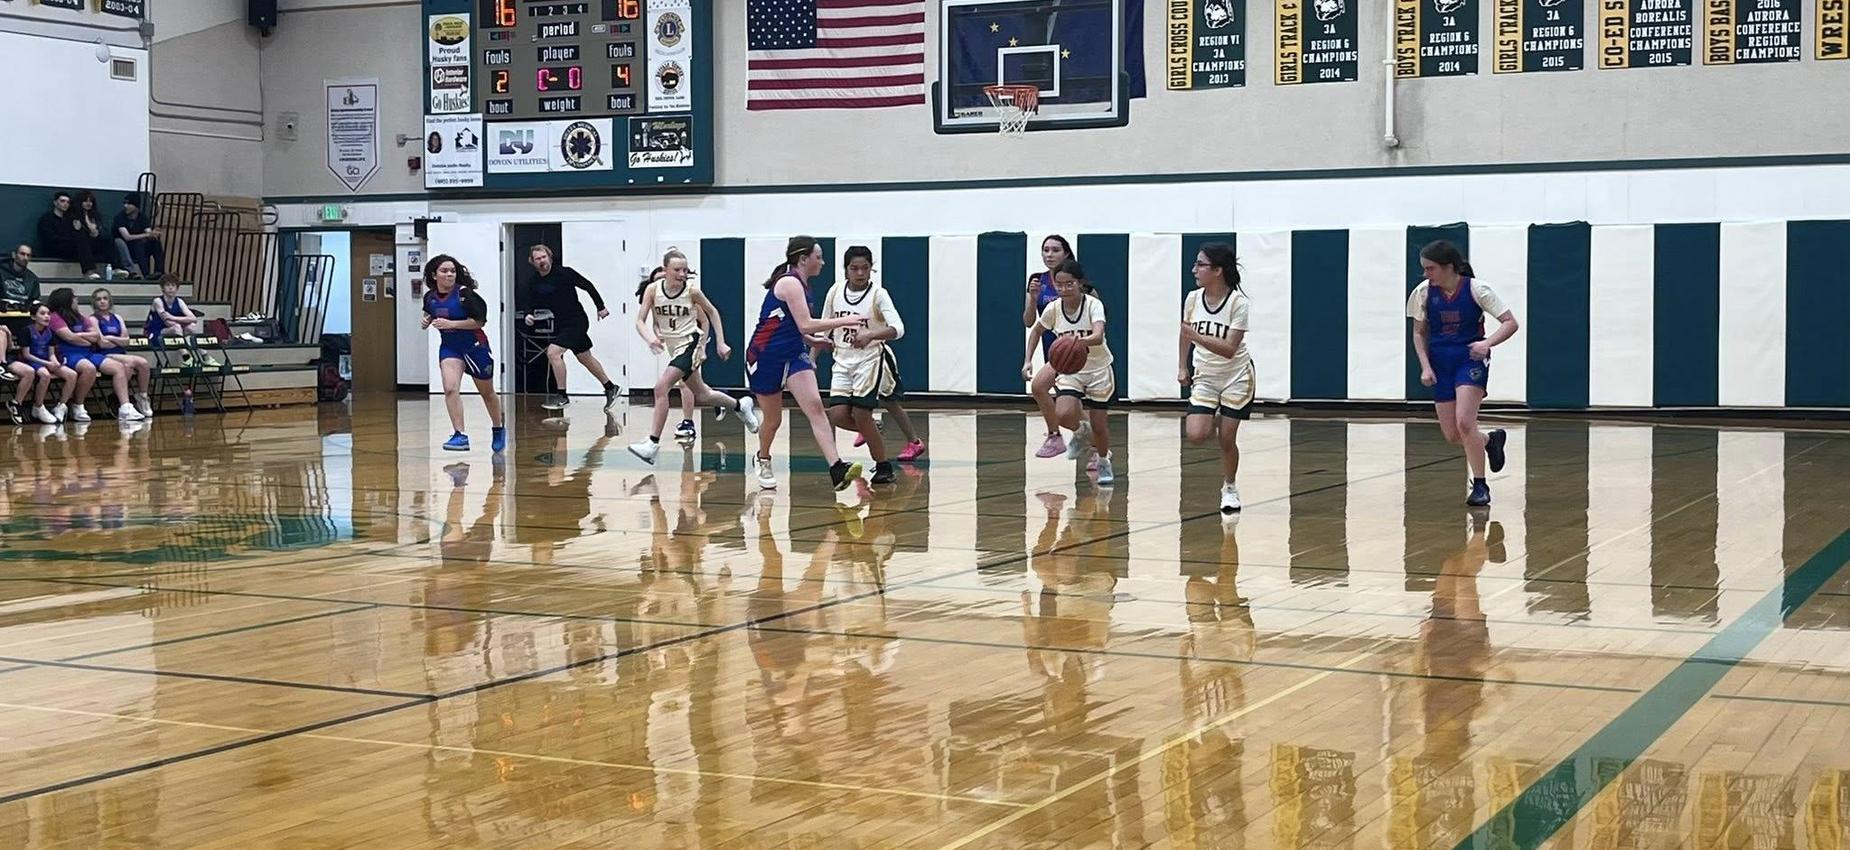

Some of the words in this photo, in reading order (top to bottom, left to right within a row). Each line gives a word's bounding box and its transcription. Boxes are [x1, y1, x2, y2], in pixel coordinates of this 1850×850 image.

[534, 7, 538, 16] 1
[548, 6, 554, 16] 2
[562, 5, 568, 15] 3
[577, 4, 583, 14] 4
[1640, 0, 1681, 9] AURORA
[1757, 0, 1781, 8] 2016
[1442, 16, 1456, 27] 3A
[1499, 0, 1518, 36] TRACK
[1546, 10, 1560, 21] 3A
[1635, 11, 1687, 23] BOREALIS
[1747, 9, 1789, 22] AURORA
[542, 21, 575, 39] period
[1281, 13, 1297, 48] TRACK
[1323, 24, 1336, 34] 3A
[1398, 7, 1416, 45] TRACK
[1532, 26, 1565, 38] REGION
[1630, 25, 1692, 38] CONFERENCE
[1736, 22, 1800, 35] CONFERENCE
[1171, 23, 1188, 55] CROSS
[1199, 36, 1228, 47] REGION
[1230, 35, 1239, 45] VI
[1429, 32, 1460, 43] REGION
[1605, 17, 1624, 66] CO-ED
[1748, 35, 1788, 47] REGION
[609, 43, 633, 58] fouls
[1311, 39, 1343, 50] REGION
[1421, 44, 1478, 57] CHAMPIONS
[1524, 39, 1583, 51] CHAMPIONS
[1630, 38, 1691, 51] CHAMPIONS
[1710, 30, 1730, 62] BOYS
[453, 54, 467, 62] fans
[486, 50, 510, 65] fouls
[543, 46, 575, 62] player
[1213, 48, 1225, 59] 3A
[1302, 51, 1358, 63] CHAMPIONS
[1500, 40, 1518, 71] GIRLS
[1649, 52, 1672, 64] 2015
[1736, 46, 1800, 59] CHAMPIONS
[1193, 60, 1245, 73] CHAMPIONS
[1281, 51, 1297, 82] GIRLS
[1398, 50, 1416, 76] BOYS
[1438, 61, 1460, 73] 2014
[1542, 56, 1565, 67] 2015
[616, 66, 629, 86] 4
[1171, 56, 1186, 87] GIRLS
[1319, 68, 1340, 79] 2014
[496, 71, 507, 92] 2
[1208, 73, 1229, 84] 2013
[489, 101, 509, 114] bout
[544, 98, 576, 112] weight
[610, 96, 631, 109] bout
[630, 152, 640, 166] Go
[655, 304, 690, 316] DELTA
[669, 318, 676, 331] 4
